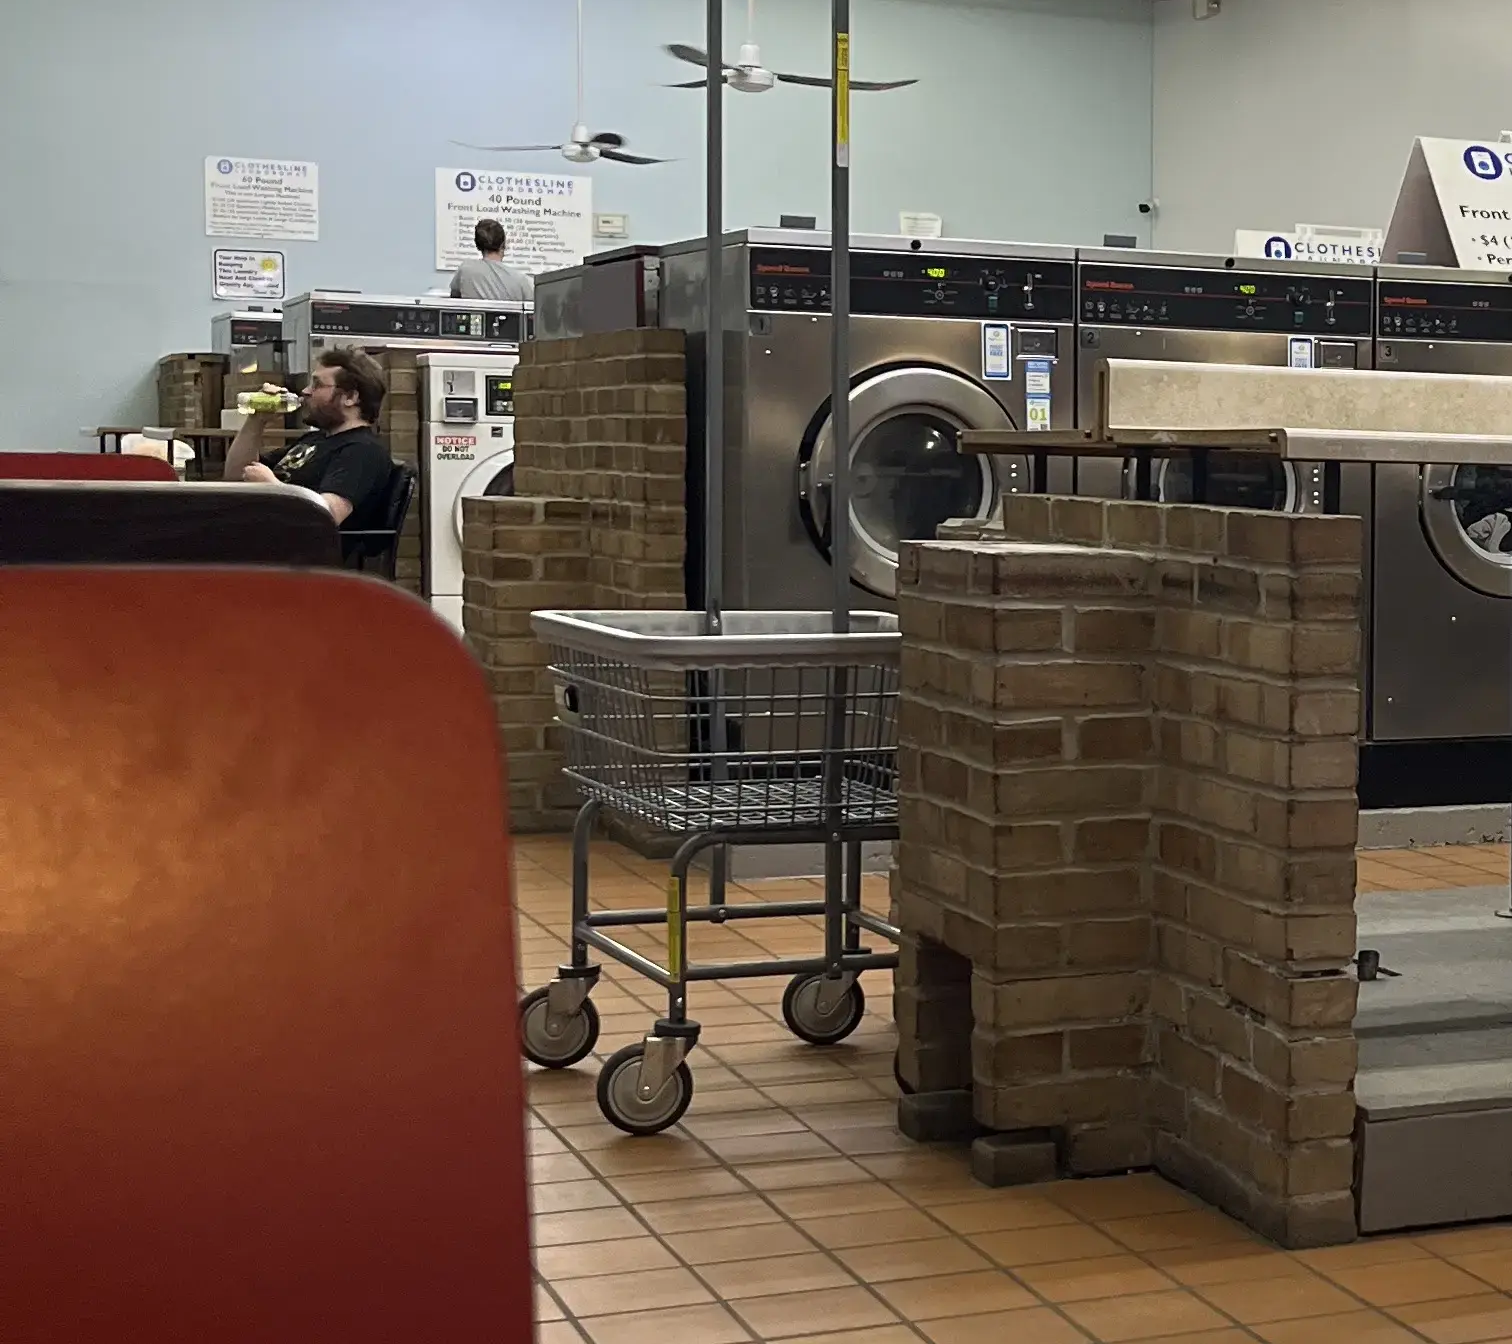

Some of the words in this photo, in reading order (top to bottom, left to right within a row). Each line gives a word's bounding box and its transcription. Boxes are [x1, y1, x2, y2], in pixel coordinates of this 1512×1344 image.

[255, 176, 283, 185] Pound
[478, 175, 573, 189] CLOTHESLINE
[478, 185, 573, 196] LAUNDROMAT
[488, 194, 502, 204] 40
[506, 195, 542, 206] Pound
[447, 203, 473, 212] Front
[476, 204, 500, 213] Load
[501, 206, 541, 218] Washing
[543, 208, 582, 218] Machine
[1458, 204, 1511, 221] Front
[1479, 234, 1499, 247] $4
[1087, 331, 1095, 343] 2
[1384, 345, 1392, 357] 3
[1029, 407, 1048, 421] 01
[436, 436, 475, 445] NOTICE
[442, 445, 453, 453] DO
[454, 445, 470, 453] NOT
[436, 453, 476, 461] OVERLOAD
